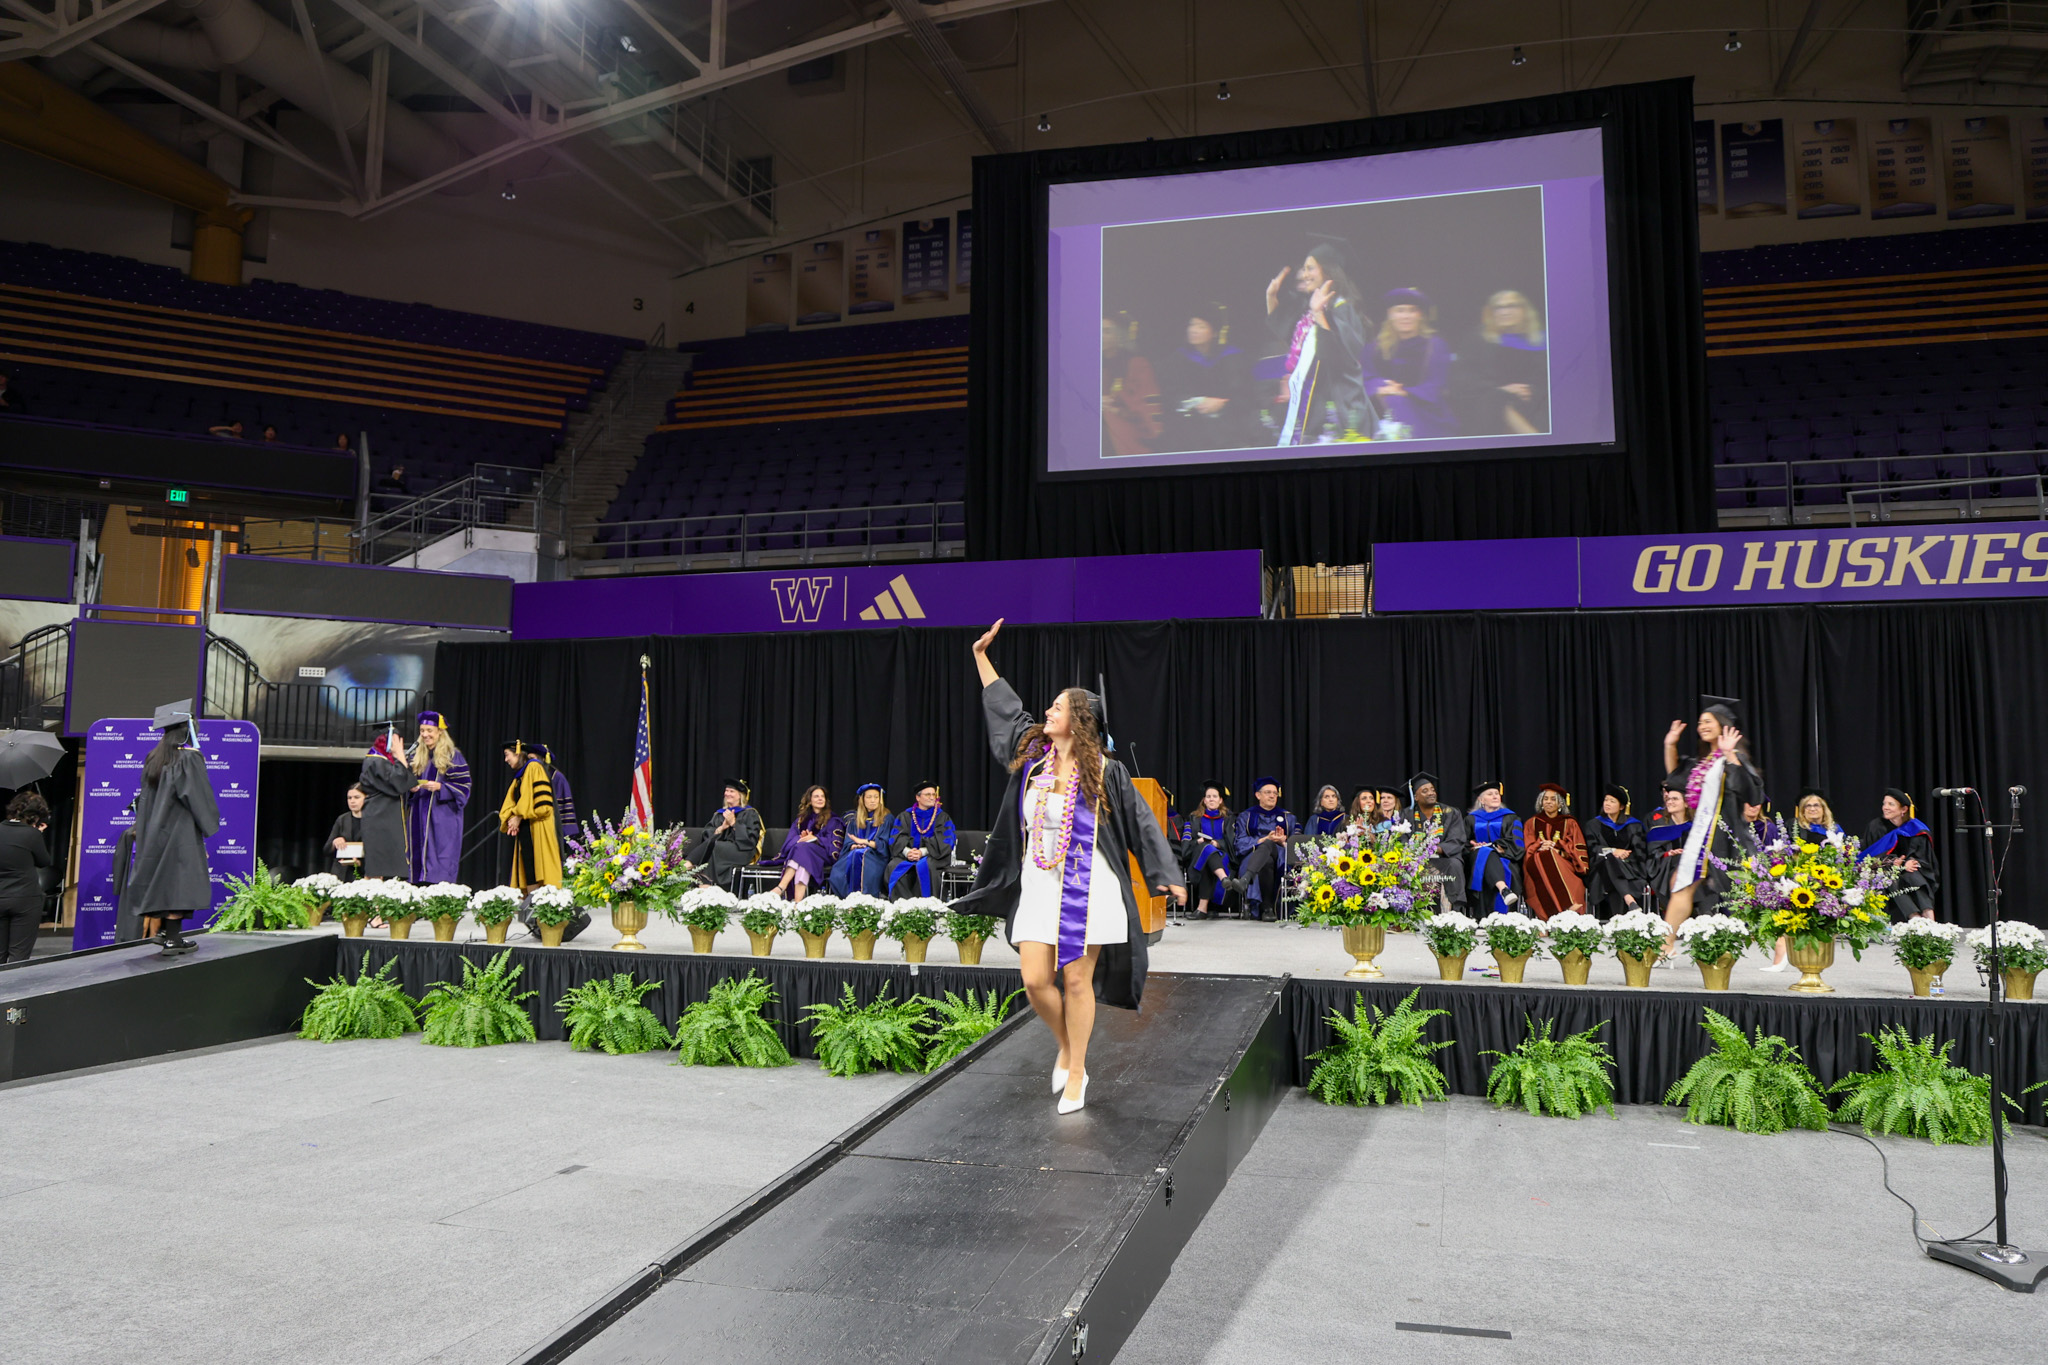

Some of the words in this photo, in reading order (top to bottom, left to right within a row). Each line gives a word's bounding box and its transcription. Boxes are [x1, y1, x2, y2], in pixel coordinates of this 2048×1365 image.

[633, 298, 643, 311] 3
[685, 302, 694, 314] 4
[170, 490, 187, 502] EXIT
[1632, 544, 1724, 594] GO
[1733, 532, 2048, 591] HUSKIES
[770, 576, 832, 623] W
